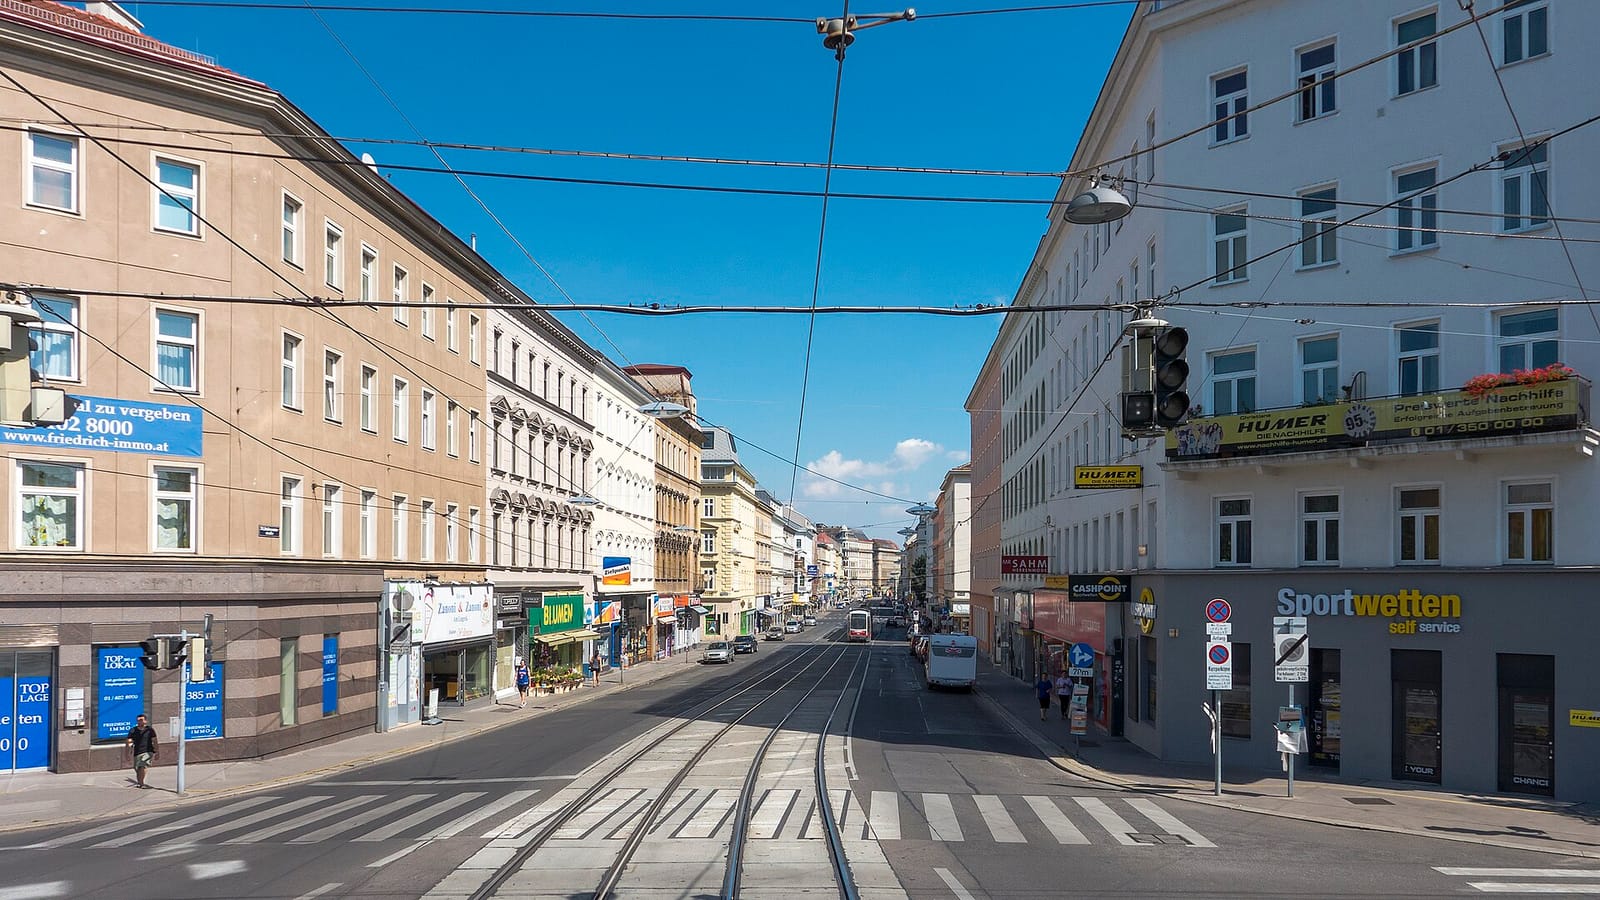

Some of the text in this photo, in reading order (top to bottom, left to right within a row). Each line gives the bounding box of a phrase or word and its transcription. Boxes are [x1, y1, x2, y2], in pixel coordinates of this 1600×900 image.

[1486, 389, 1563, 404] Nachhilfe
[95, 404, 116, 414] zu
[120, 404, 190, 422] vergeben
[86, 418, 133, 436] 8000
[1238, 415, 1327, 433] HUMER
[1494, 419, 1515, 430] 00
[1522, 417, 1544, 428] 00
[4, 431, 169, 452] www.friedrich-immo.at
[1079, 471, 1137, 479] HUMER
[1012, 559, 1047, 568] SAHM
[1072, 584, 1128, 593] CASHPOINT
[1277, 588, 1462, 617] Sportwetten
[544, 604, 574, 625] BLUMEN
[1389, 620, 1461, 634] self service
[104, 655, 123, 664] TOP
[20, 683, 50, 694] TOP
[20, 694, 49, 702] LAGE
[187, 691, 204, 700] 385
[1411, 766, 1434, 775] YOUR
